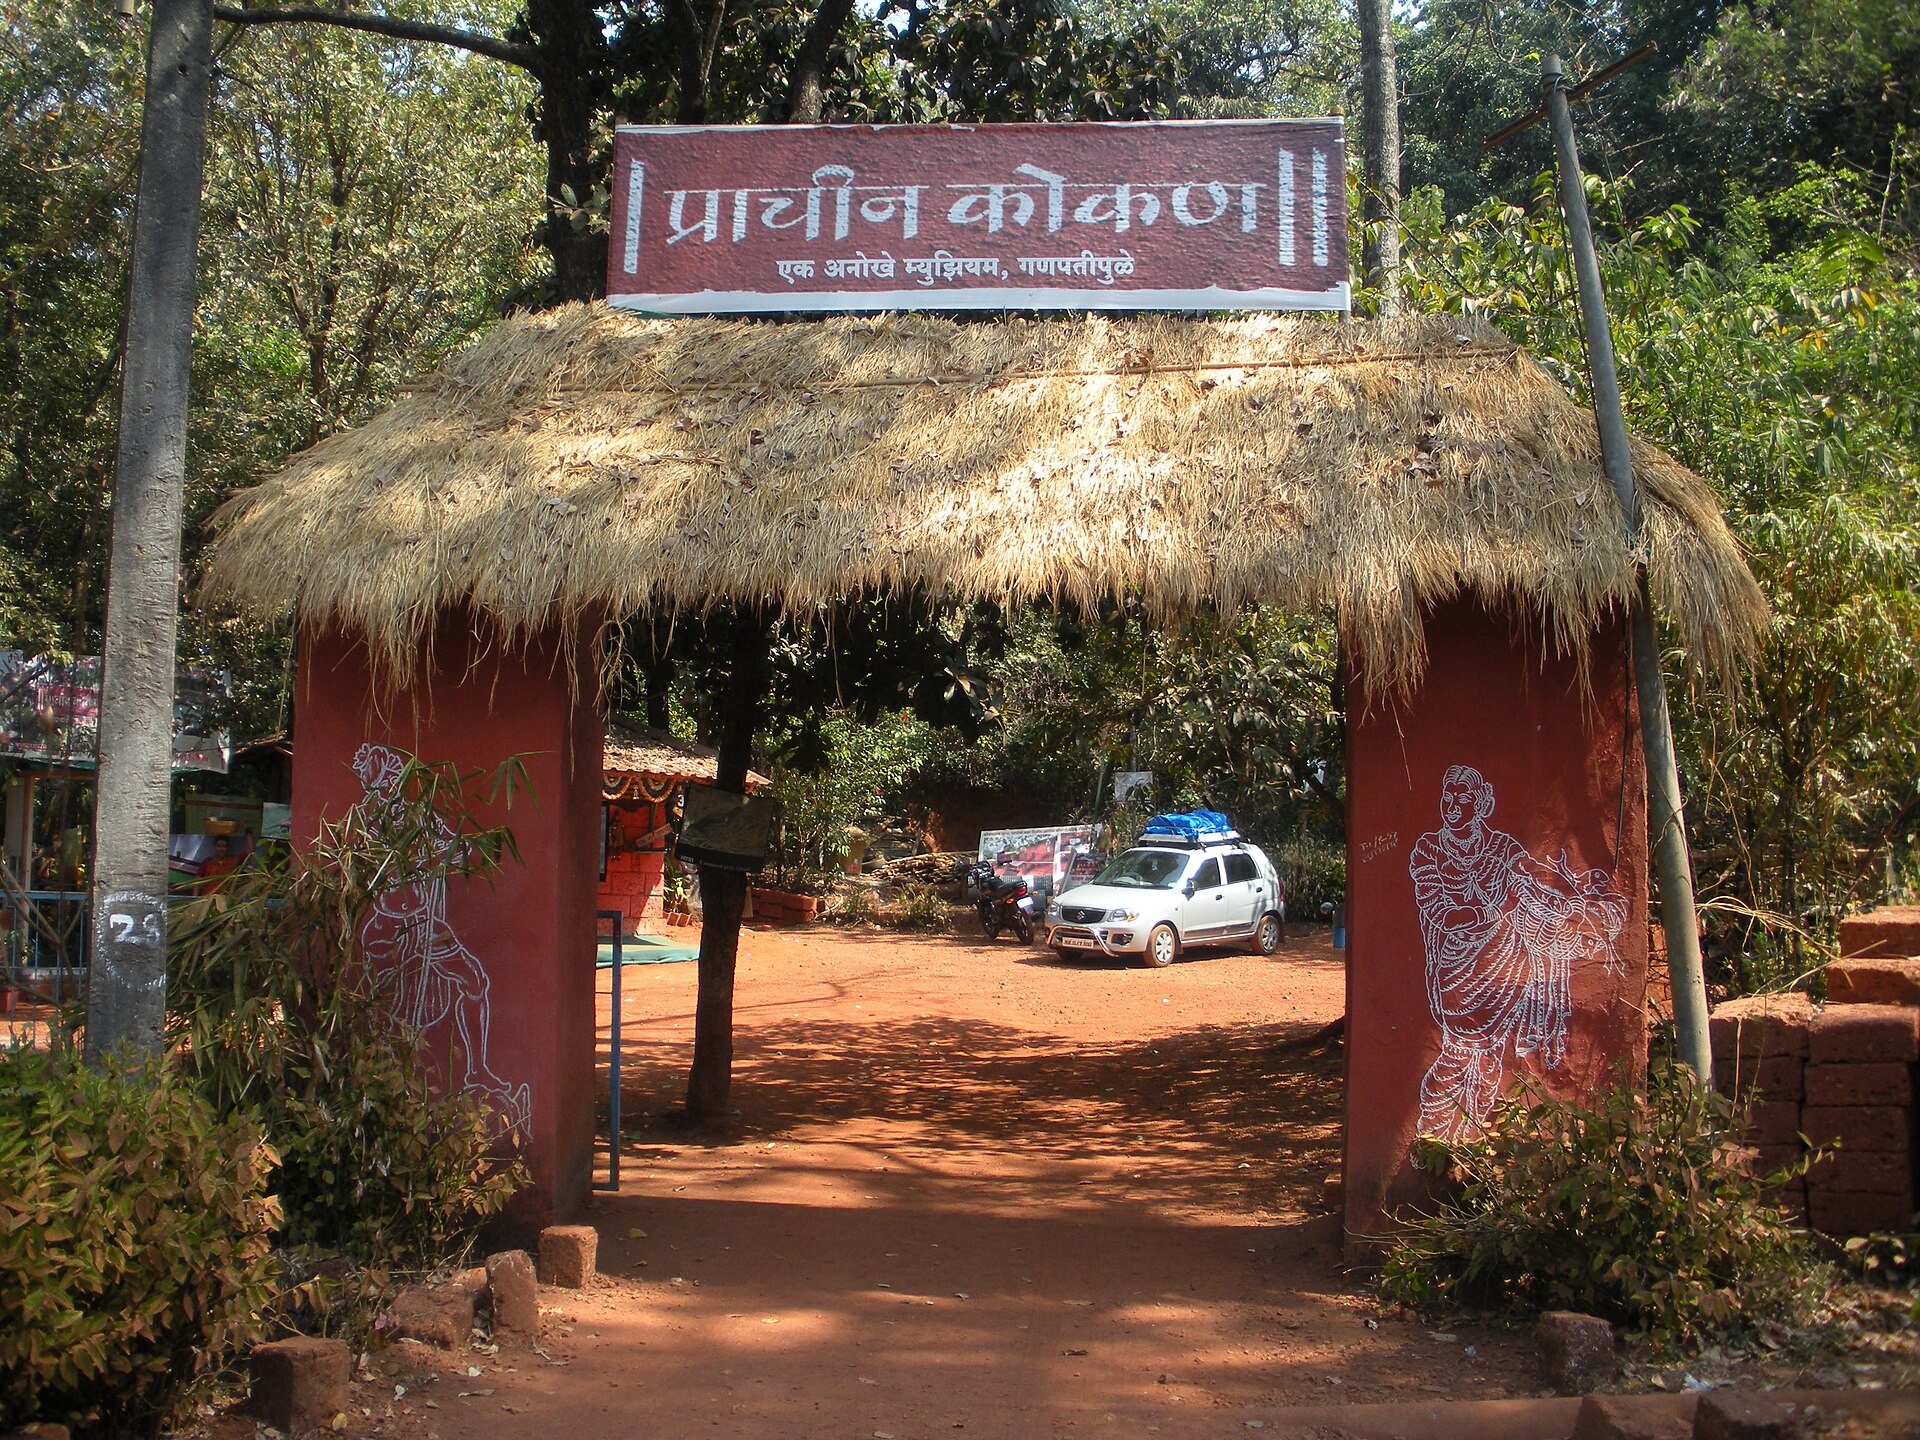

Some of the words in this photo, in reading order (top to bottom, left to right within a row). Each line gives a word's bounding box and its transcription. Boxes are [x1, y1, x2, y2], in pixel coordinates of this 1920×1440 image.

[664, 164, 930, 244] प्राचीन
[946, 163, 1269, 233] कोकण
[775, 259, 816, 284] एक
[823, 250, 896, 279] अनोखे
[1017, 249, 1135, 285] गणपतीपुळे
